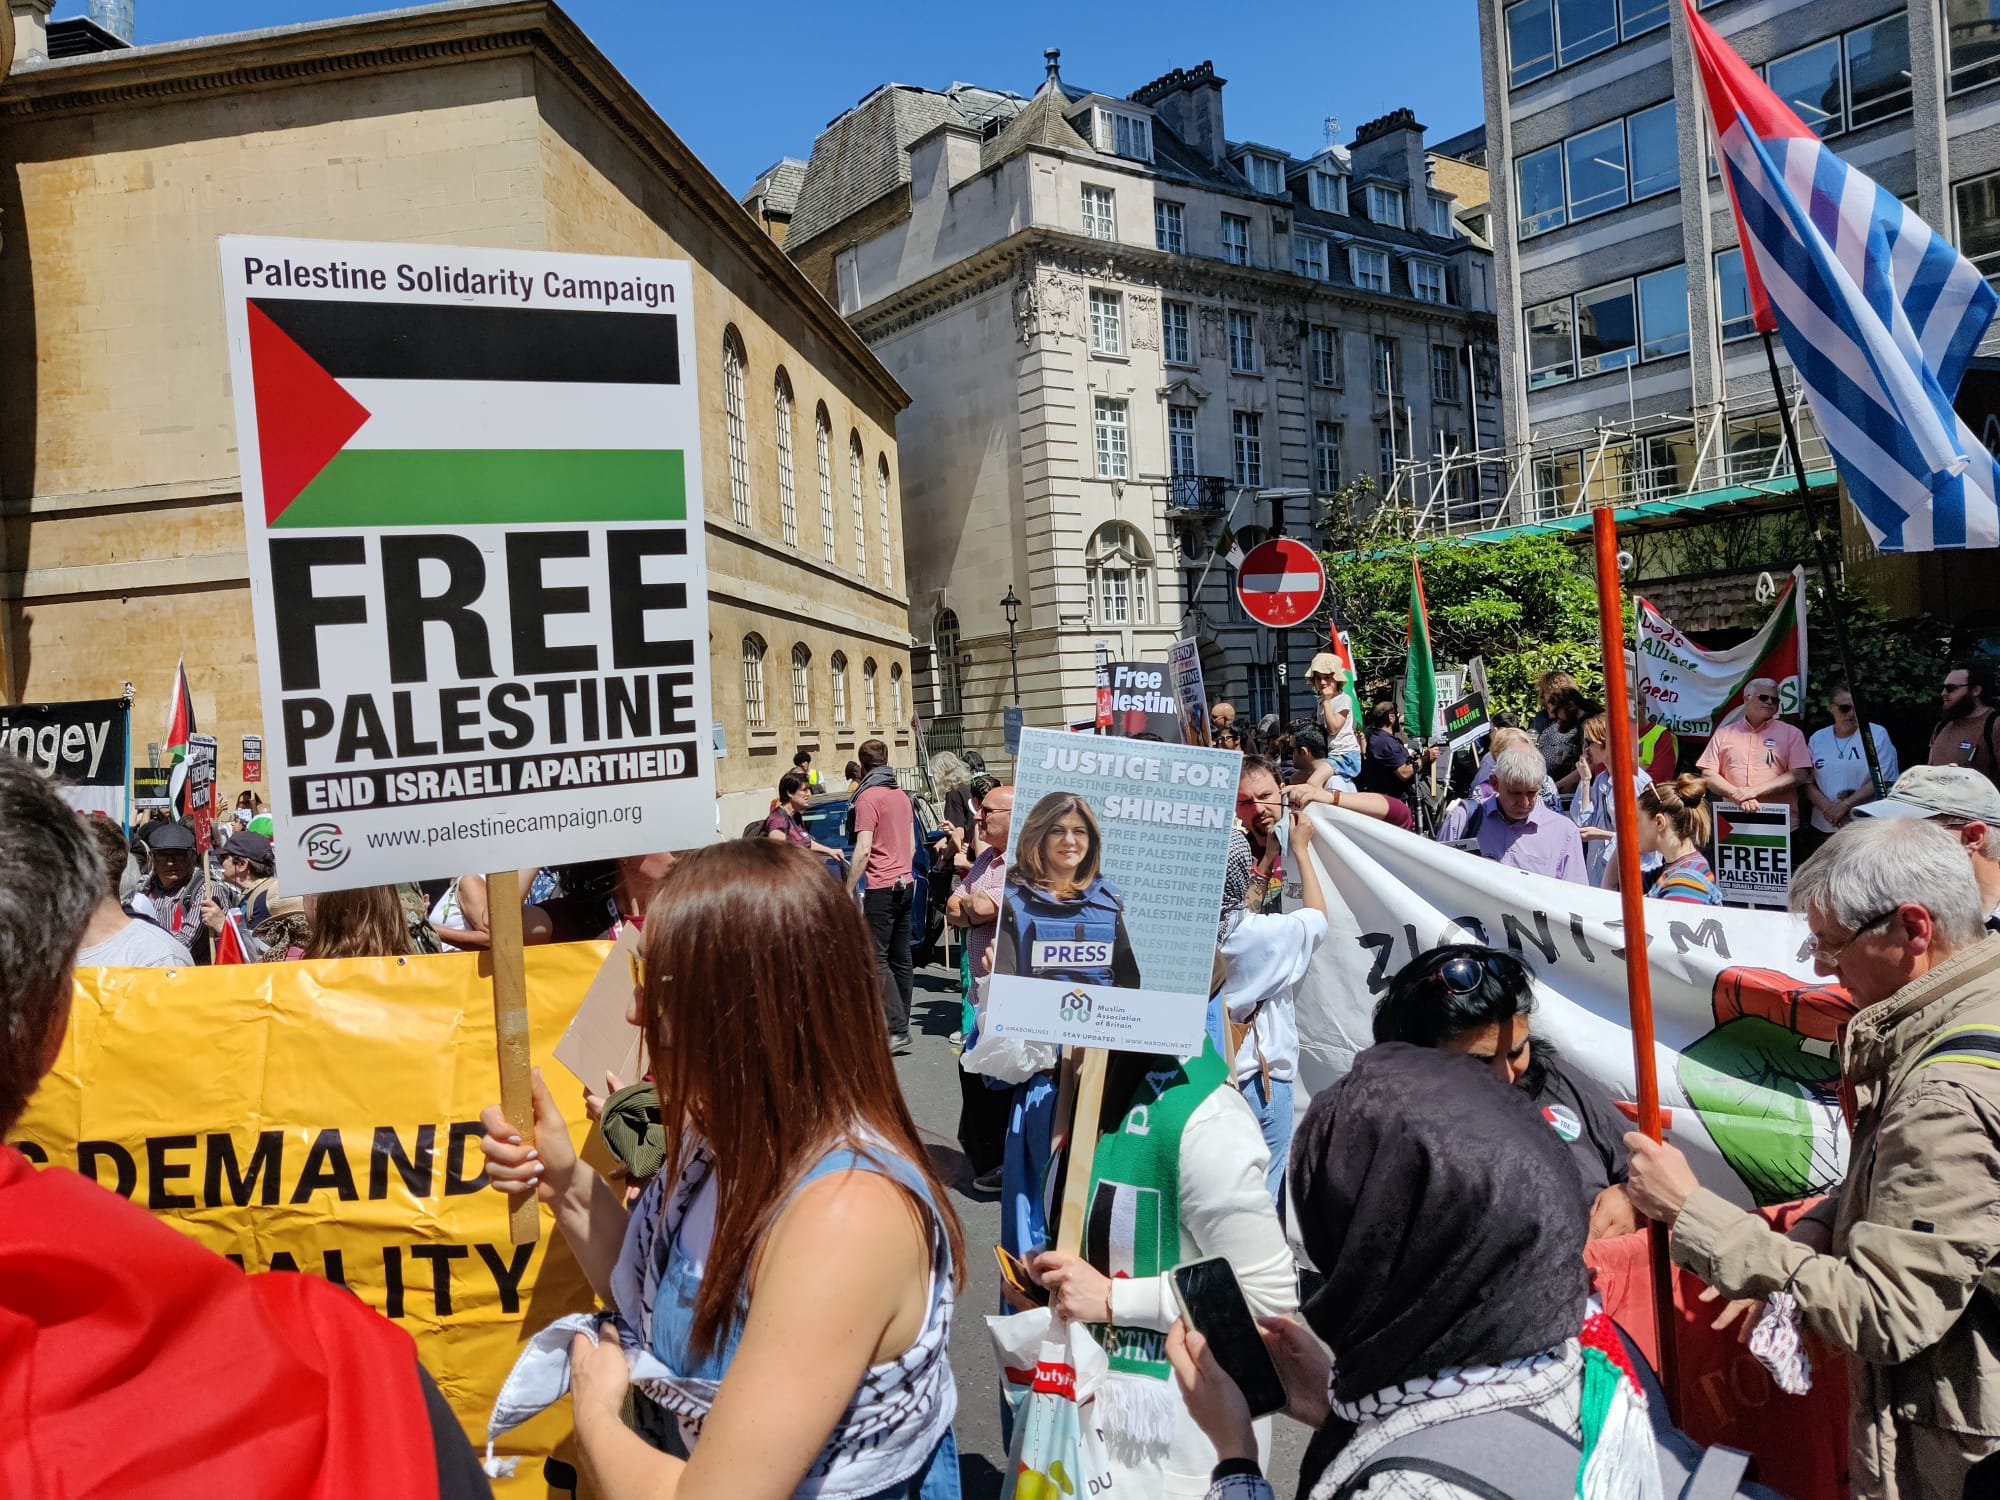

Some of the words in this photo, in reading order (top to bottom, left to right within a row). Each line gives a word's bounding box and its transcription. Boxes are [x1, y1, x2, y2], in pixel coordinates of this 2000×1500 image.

[244, 257, 386, 292] Palestine
[397, 264, 533, 303] Solidarity
[544, 271, 675, 308] Campaign
[268, 528, 695, 691] FREE
[1114, 667, 1162, 690] Free
[1111, 690, 1178, 714] lestin
[282, 671, 696, 768] PALESTINE
[1449, 708, 1481, 732] PALESTINE
[1040, 748, 1160, 782] JUSTICE
[1171, 761, 1230, 789] FOR
[306, 777, 375, 811] END
[386, 762, 511, 803] ISRAELI
[519, 748, 686, 791] APARTHEID
[1046, 775, 1112, 792] PALESTINE
[1114, 783, 1142, 795] FREE
[1146, 786, 1211, 802] PALESTINE
[1213, 793, 1234, 805] FRE
[1103, 795, 1226, 829] SHIREEN
[367, 803, 643, 849] www.palestinecampaign.org
[308, 838, 343, 857] PSC
[1108, 828, 1137, 841] FREE
[1140, 831, 1204, 848] PALESTINE
[1106, 844, 1135, 856] FREE
[1138, 847, 1202, 863] PALESTINE
[1718, 846, 1788, 872] FREE
[1104, 859, 1133, 871] FREE
[1136, 862, 1200, 878] PALESTINE
[1719, 869, 1788, 885] PALESTINE
[1103, 874, 1131, 886] FREE
[1134, 877, 1198, 892] PALESTINE
[1132, 891, 1197, 907] PALESTINE
[1130, 907, 1193, 922] PALESTINE
[1044, 945, 1106, 963] PRESS
[1096, 1013, 1142, 1022] Association
[1097, 1005, 1126, 1013] Muslim
[1105, 1020, 1132, 1030] Britain
[1062, 1032, 1081, 1040] STAY
[1082, 1033, 1116, 1043] UPDATED
[77, 1121, 493, 1210] DEMAND
